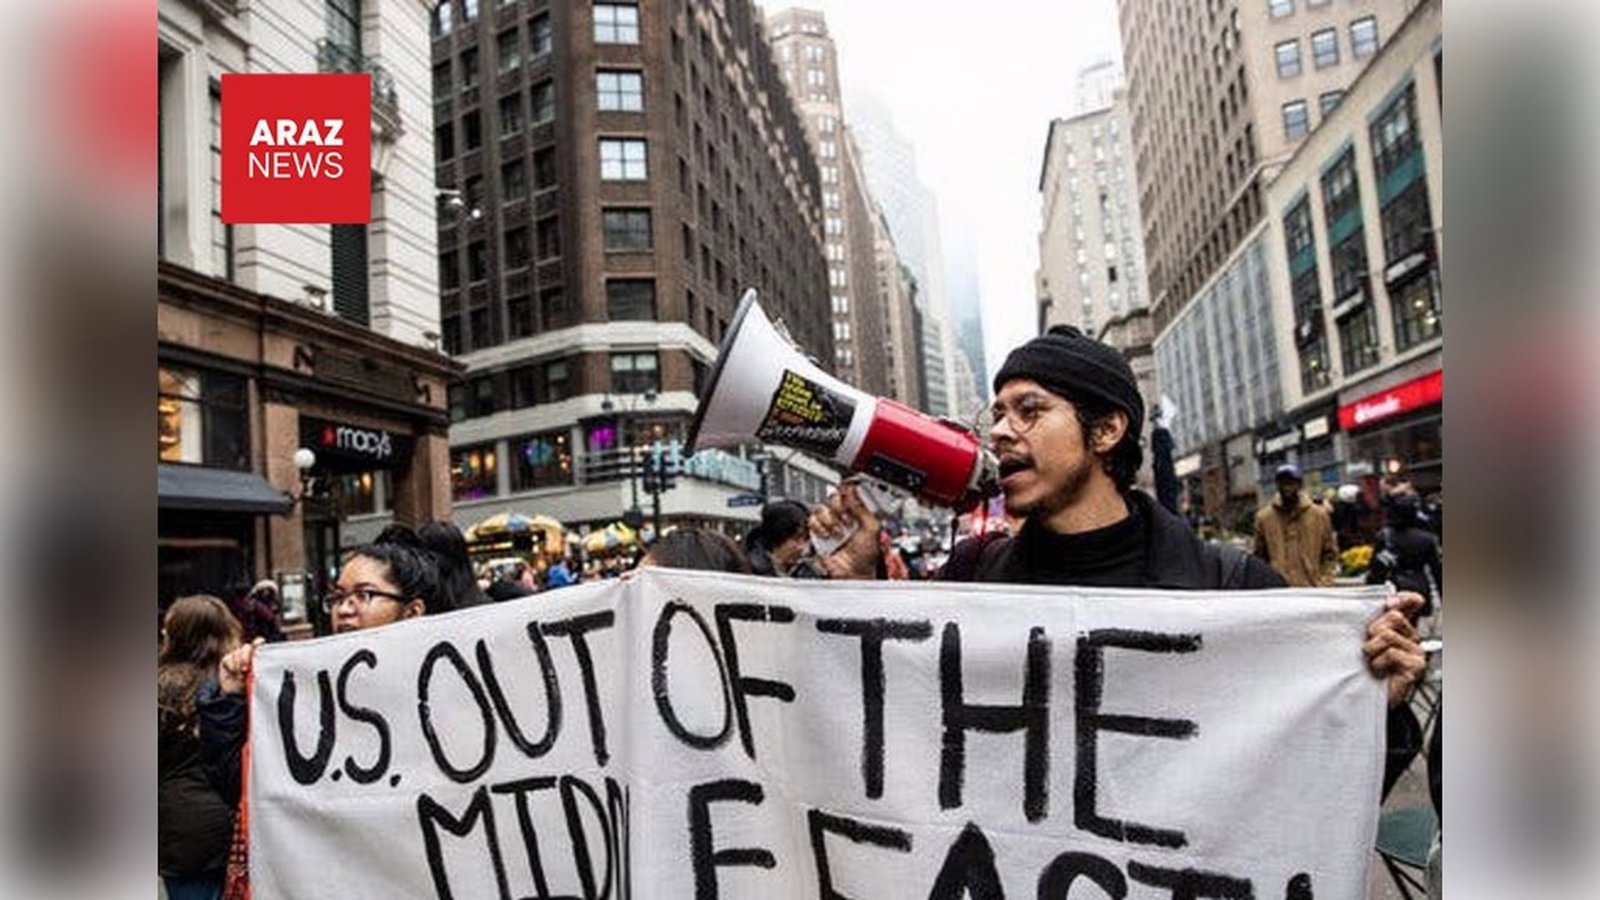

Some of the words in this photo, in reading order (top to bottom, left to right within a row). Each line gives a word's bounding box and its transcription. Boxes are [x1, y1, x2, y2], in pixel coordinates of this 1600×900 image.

[278, 649, 401, 787] U.S.
[418, 609, 614, 784] OUT
[652, 599, 796, 760] OF
[815, 617, 1202, 848] THE
